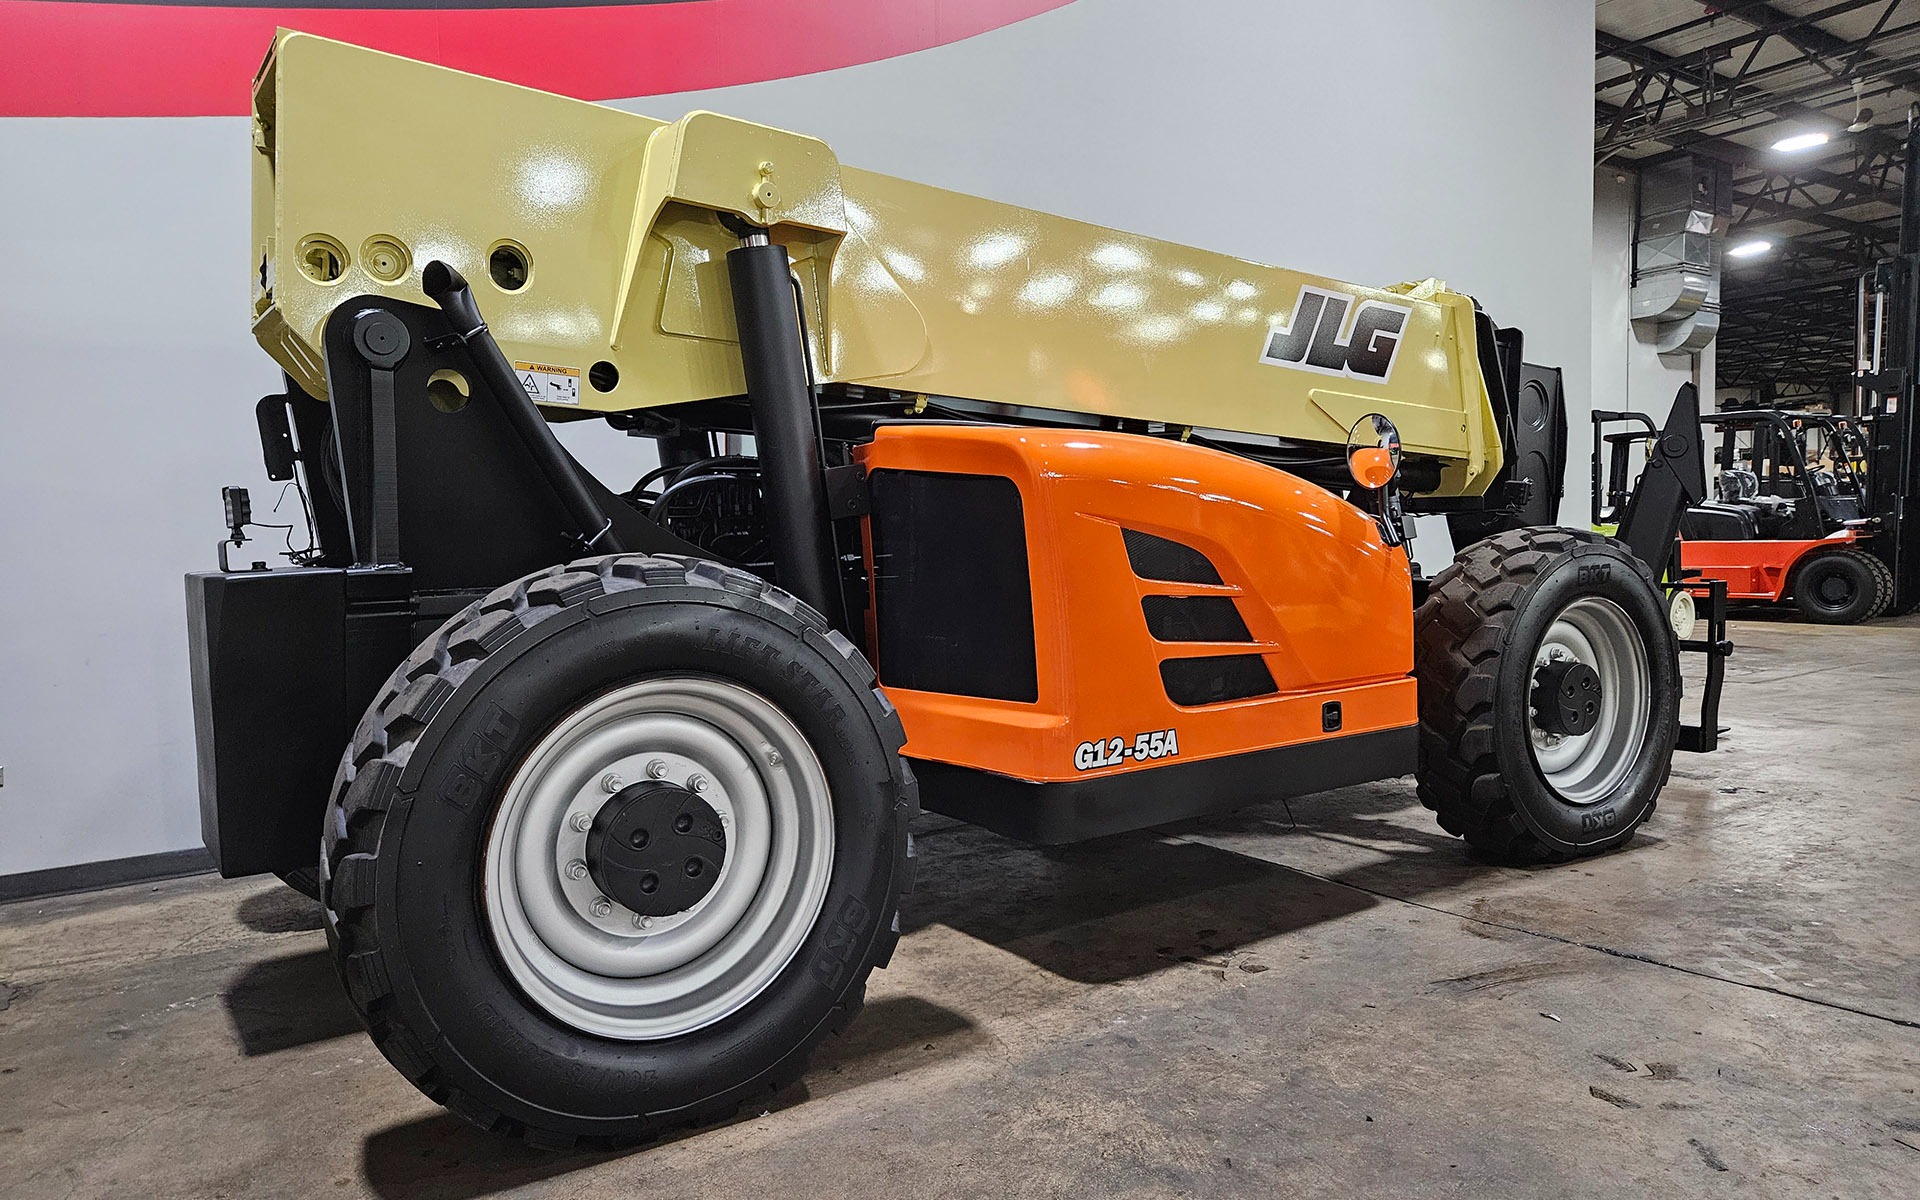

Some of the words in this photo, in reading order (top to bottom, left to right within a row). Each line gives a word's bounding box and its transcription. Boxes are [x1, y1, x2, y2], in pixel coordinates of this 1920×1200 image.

[1264, 289, 1408, 380] JLG
[537, 365, 567, 374] WARNING
[1578, 563, 1611, 586] BKT
[702, 627, 781, 668] LIFT
[440, 704, 517, 813] BKT
[1074, 728, 1179, 771] G12-55A
[1582, 808, 1616, 835] BKT
[813, 896, 868, 988] BKT
